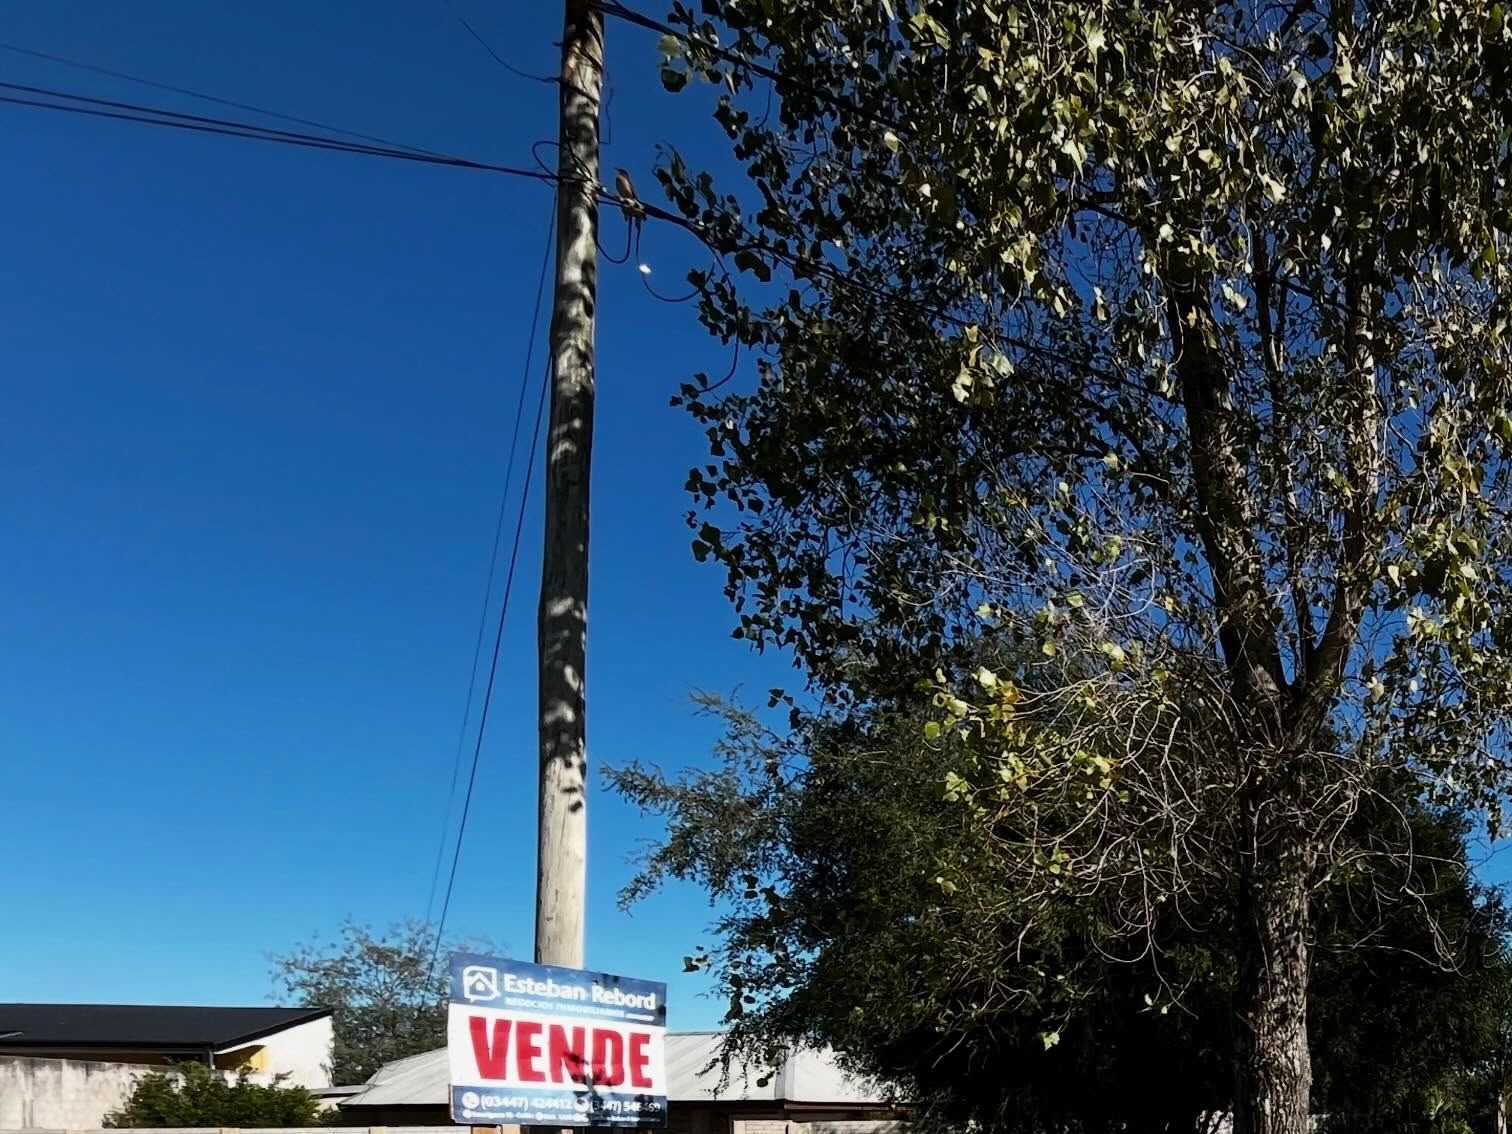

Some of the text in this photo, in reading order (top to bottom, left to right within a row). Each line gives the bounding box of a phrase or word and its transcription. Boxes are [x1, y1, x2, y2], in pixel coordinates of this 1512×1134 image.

[503, 973, 656, 1010] Esteban Rebord
[468, 1016, 653, 1089] VENDE
